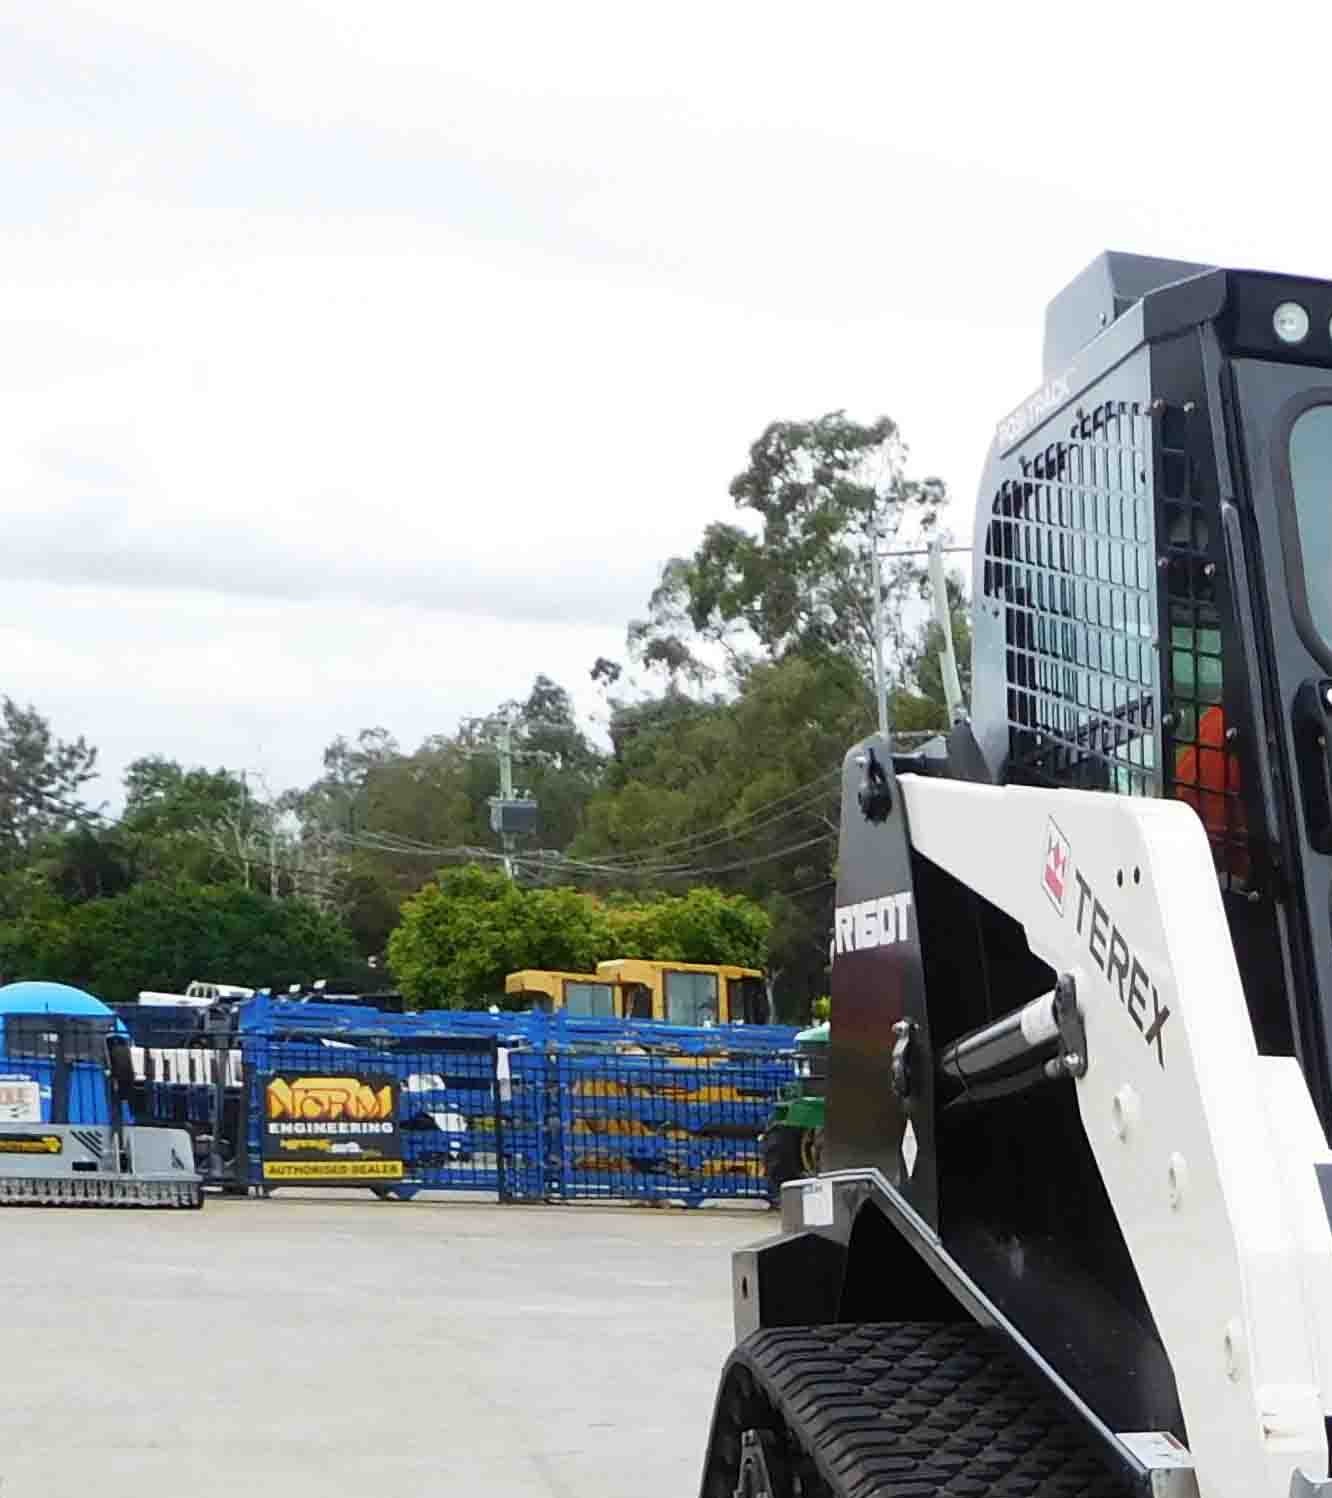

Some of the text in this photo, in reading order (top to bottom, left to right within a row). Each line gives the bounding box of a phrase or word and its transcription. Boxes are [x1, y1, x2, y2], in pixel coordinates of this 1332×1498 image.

[1076, 868, 1170, 1071] TEREX
[266, 1077, 393, 1119] NORM
[267, 1122, 394, 1135] ENGINEERING
